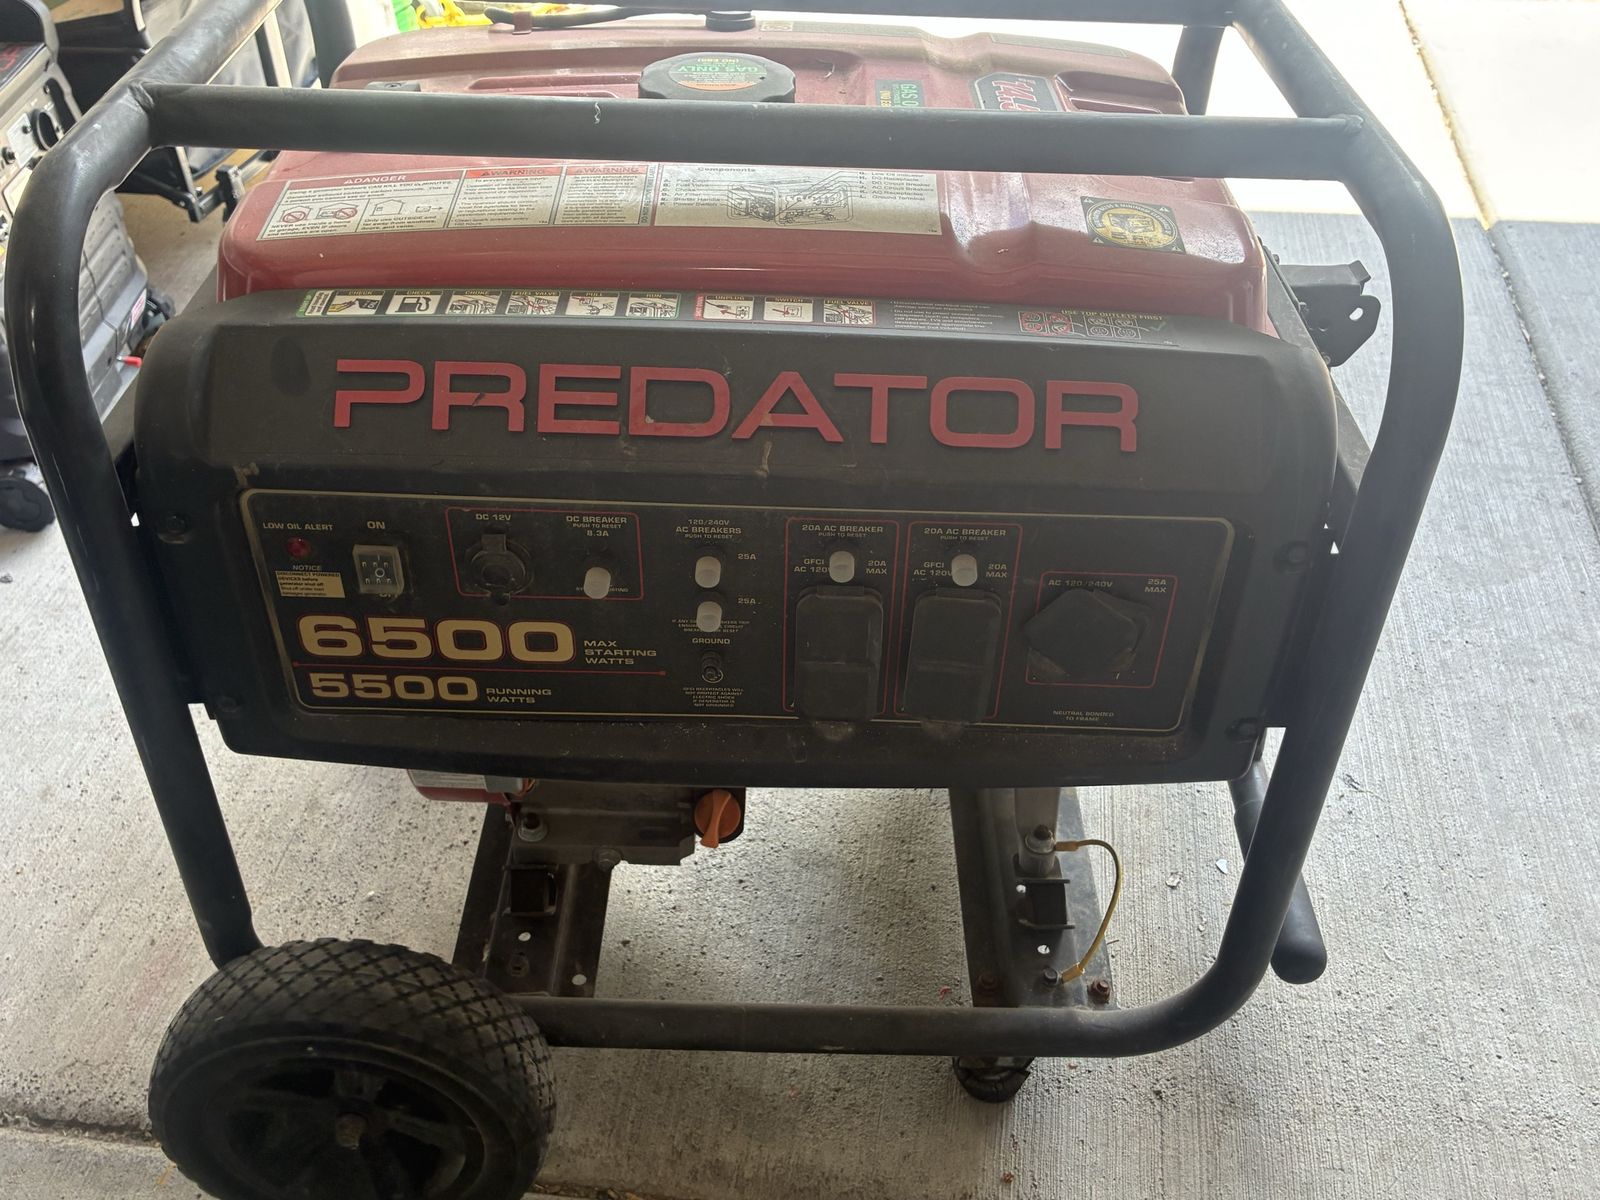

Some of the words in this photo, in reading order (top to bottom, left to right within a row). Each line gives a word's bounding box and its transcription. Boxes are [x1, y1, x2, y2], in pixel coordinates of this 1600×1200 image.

[352, 175, 407, 185] DANGER
[333, 357, 1140, 454] PREDATOR
[475, 513, 492, 521] DC
[494, 514, 512, 522] 12V
[566, 515, 581, 523] DC
[583, 516, 628, 524] BREAKER
[263, 522, 284, 531] LOW
[287, 522, 302, 531] OIL
[304, 523, 334, 532] ALERT
[366, 520, 386, 530] ON
[802, 524, 821, 532] 20A
[823, 525, 838, 533] AC
[840, 525, 884, 534] BREAKER
[587, 529, 610, 538] 8.3A
[691, 527, 742, 535] BREAKERS
[925, 527, 944, 535] 20A
[946, 528, 960, 536] AC
[962, 528, 1007, 537] BREAKER
[737, 553, 757, 561] 25A
[803, 558, 825, 566] GFCI
[867, 560, 887, 568] 20A
[923, 561, 945, 569] GFCI
[987, 563, 1008, 571] 20A
[865, 568, 888, 576] MAX
[985, 570, 1008, 578] MAX
[1147, 578, 1167, 586] 25A
[737, 597, 756, 605] 25A
[297, 613, 577, 664] 6500
[691, 637, 731, 645] GROUND
[583, 639, 617, 648] MAX
[583, 647, 657, 658] STARTING
[584, 656, 635, 666] WATTS
[309, 671, 480, 703] 5500
[485, 687, 552, 697] RUNNING
[487, 695, 536, 705] WATTS
